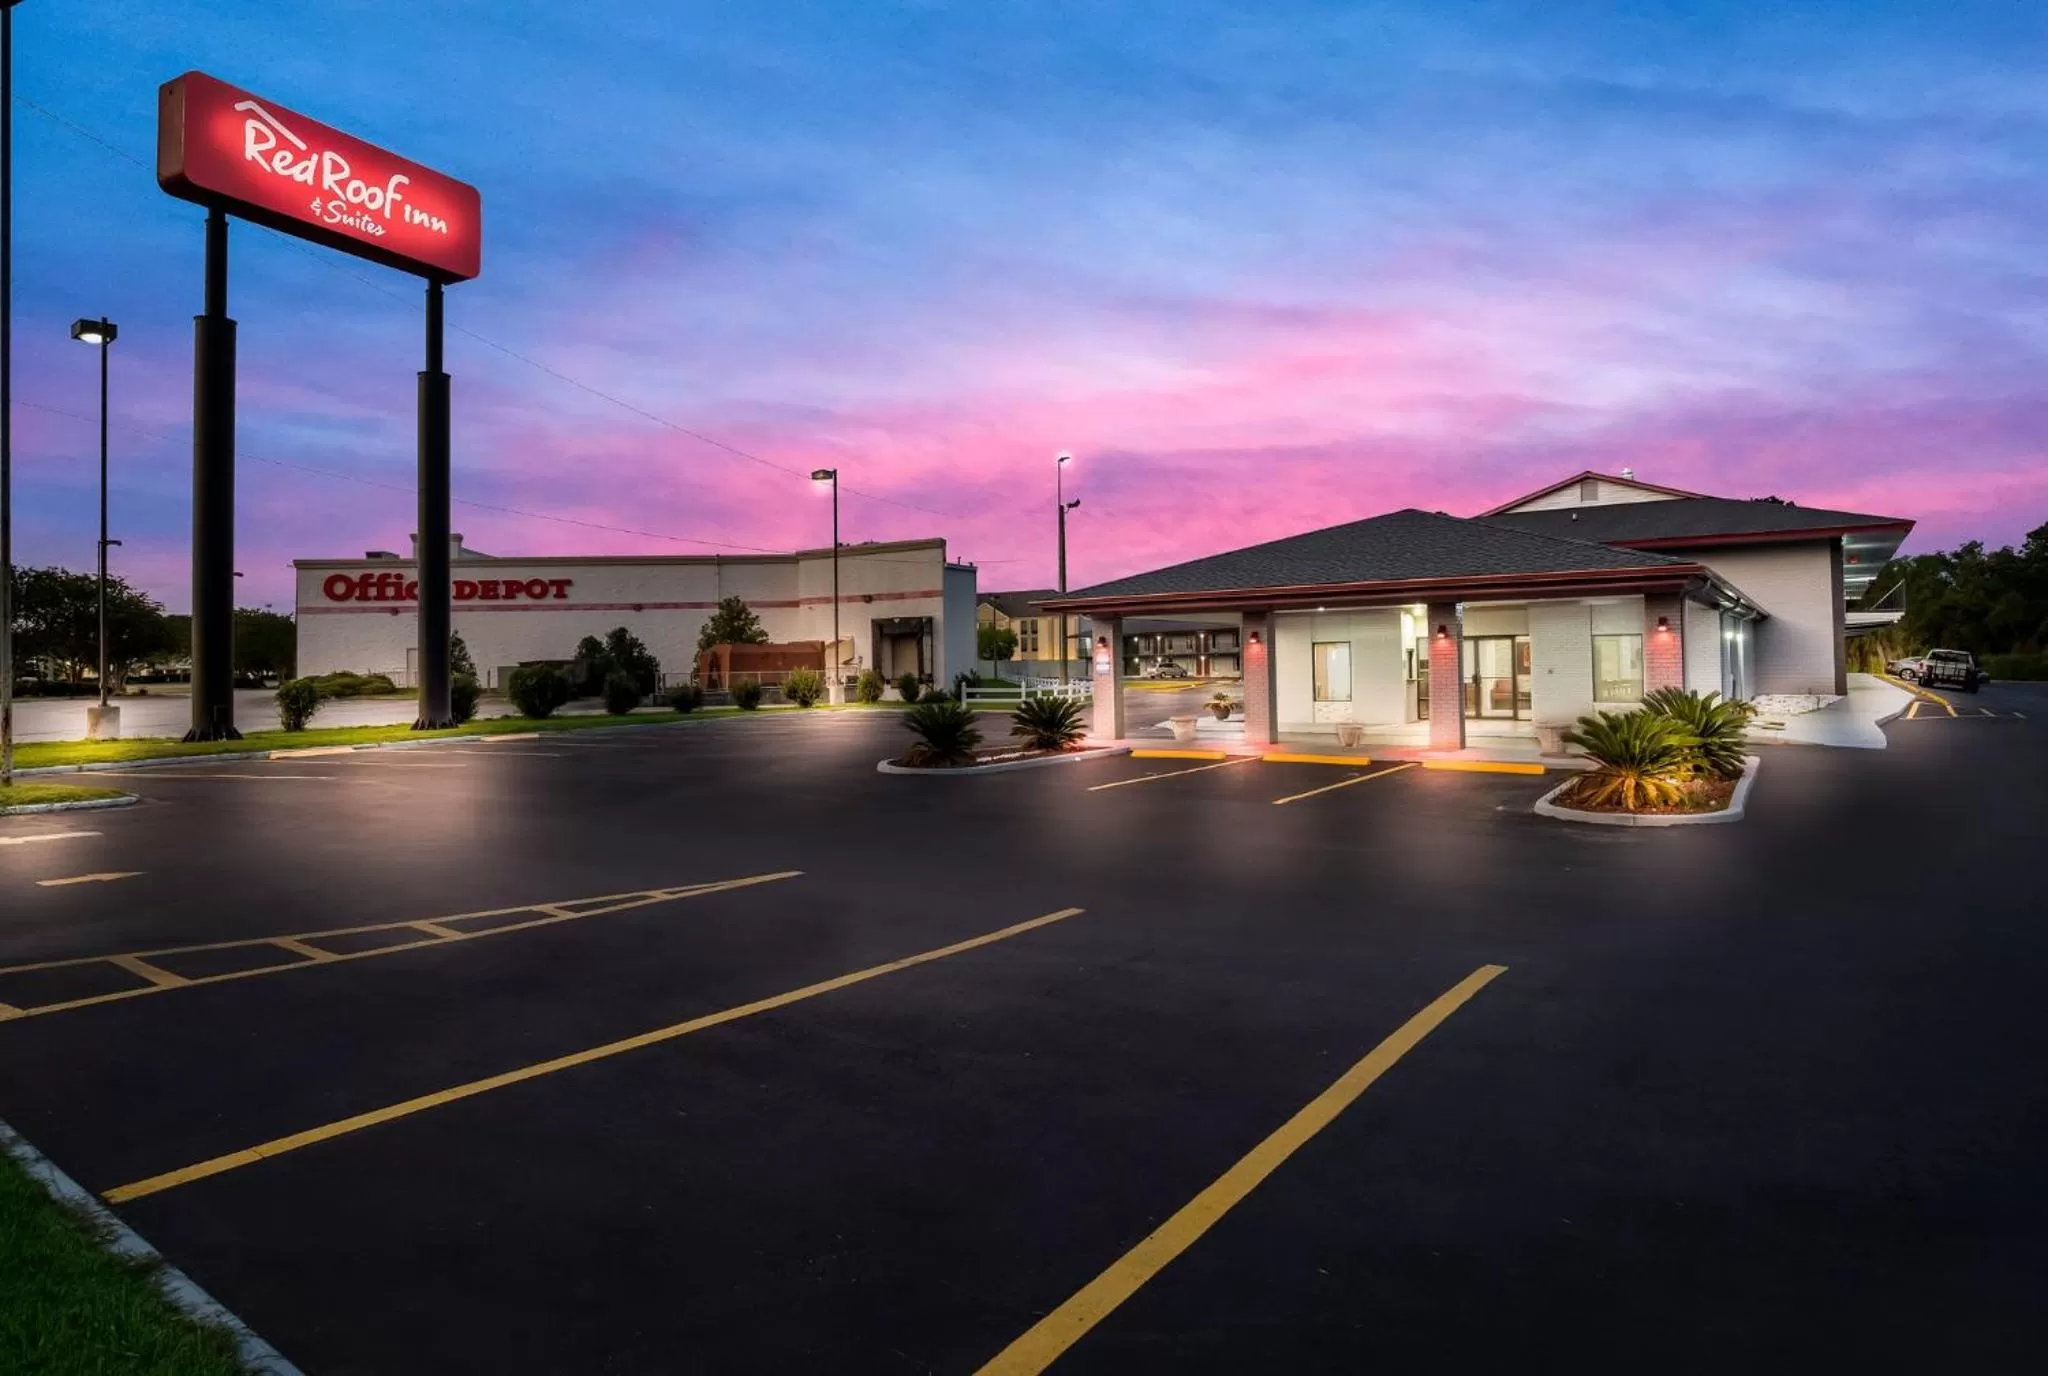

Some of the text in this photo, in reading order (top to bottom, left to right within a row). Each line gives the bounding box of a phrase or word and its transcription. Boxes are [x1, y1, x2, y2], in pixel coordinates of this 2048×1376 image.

[310, 197, 386, 236] & Suites
[323, 573, 573, 601] Offic DEPOT
